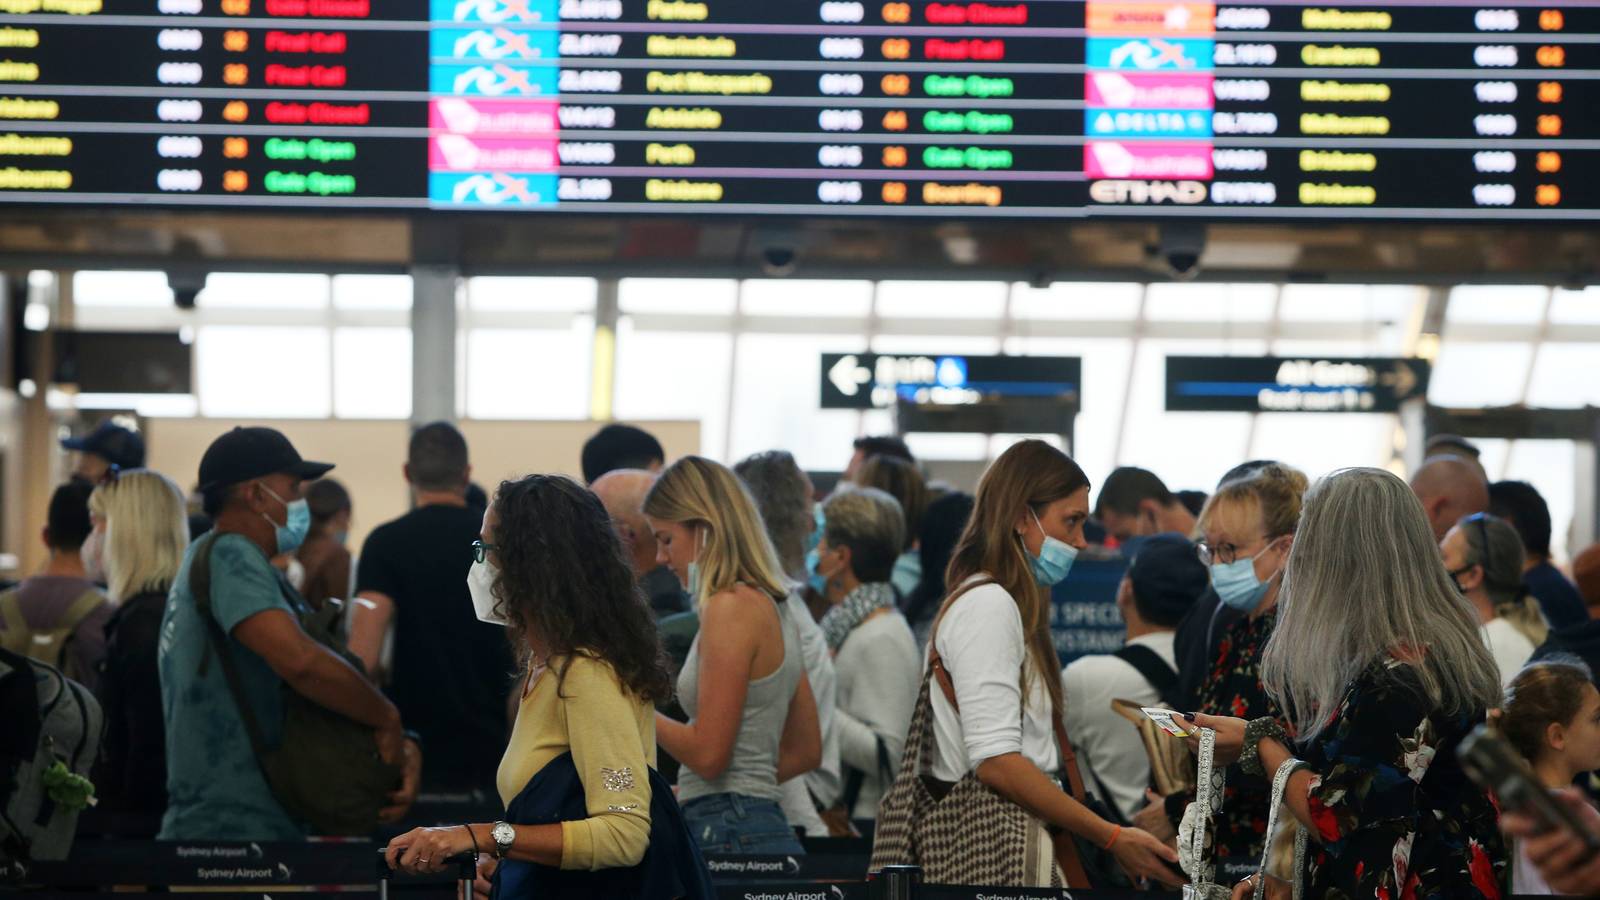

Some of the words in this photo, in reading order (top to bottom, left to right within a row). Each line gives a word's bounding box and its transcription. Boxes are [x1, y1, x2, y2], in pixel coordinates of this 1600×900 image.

[1090, 180, 1207, 203] ETIHAD
[176, 845, 211, 858] Sydney
[212, 846, 248, 858] Airport
[708, 860, 746, 872] Sydney
[746, 860, 784, 872] Airport
[197, 867, 236, 880] Sydney
[236, 867, 272, 880] Airport
[744, 892, 786, 900] Sydney
[787, 891, 827, 900] Airport
